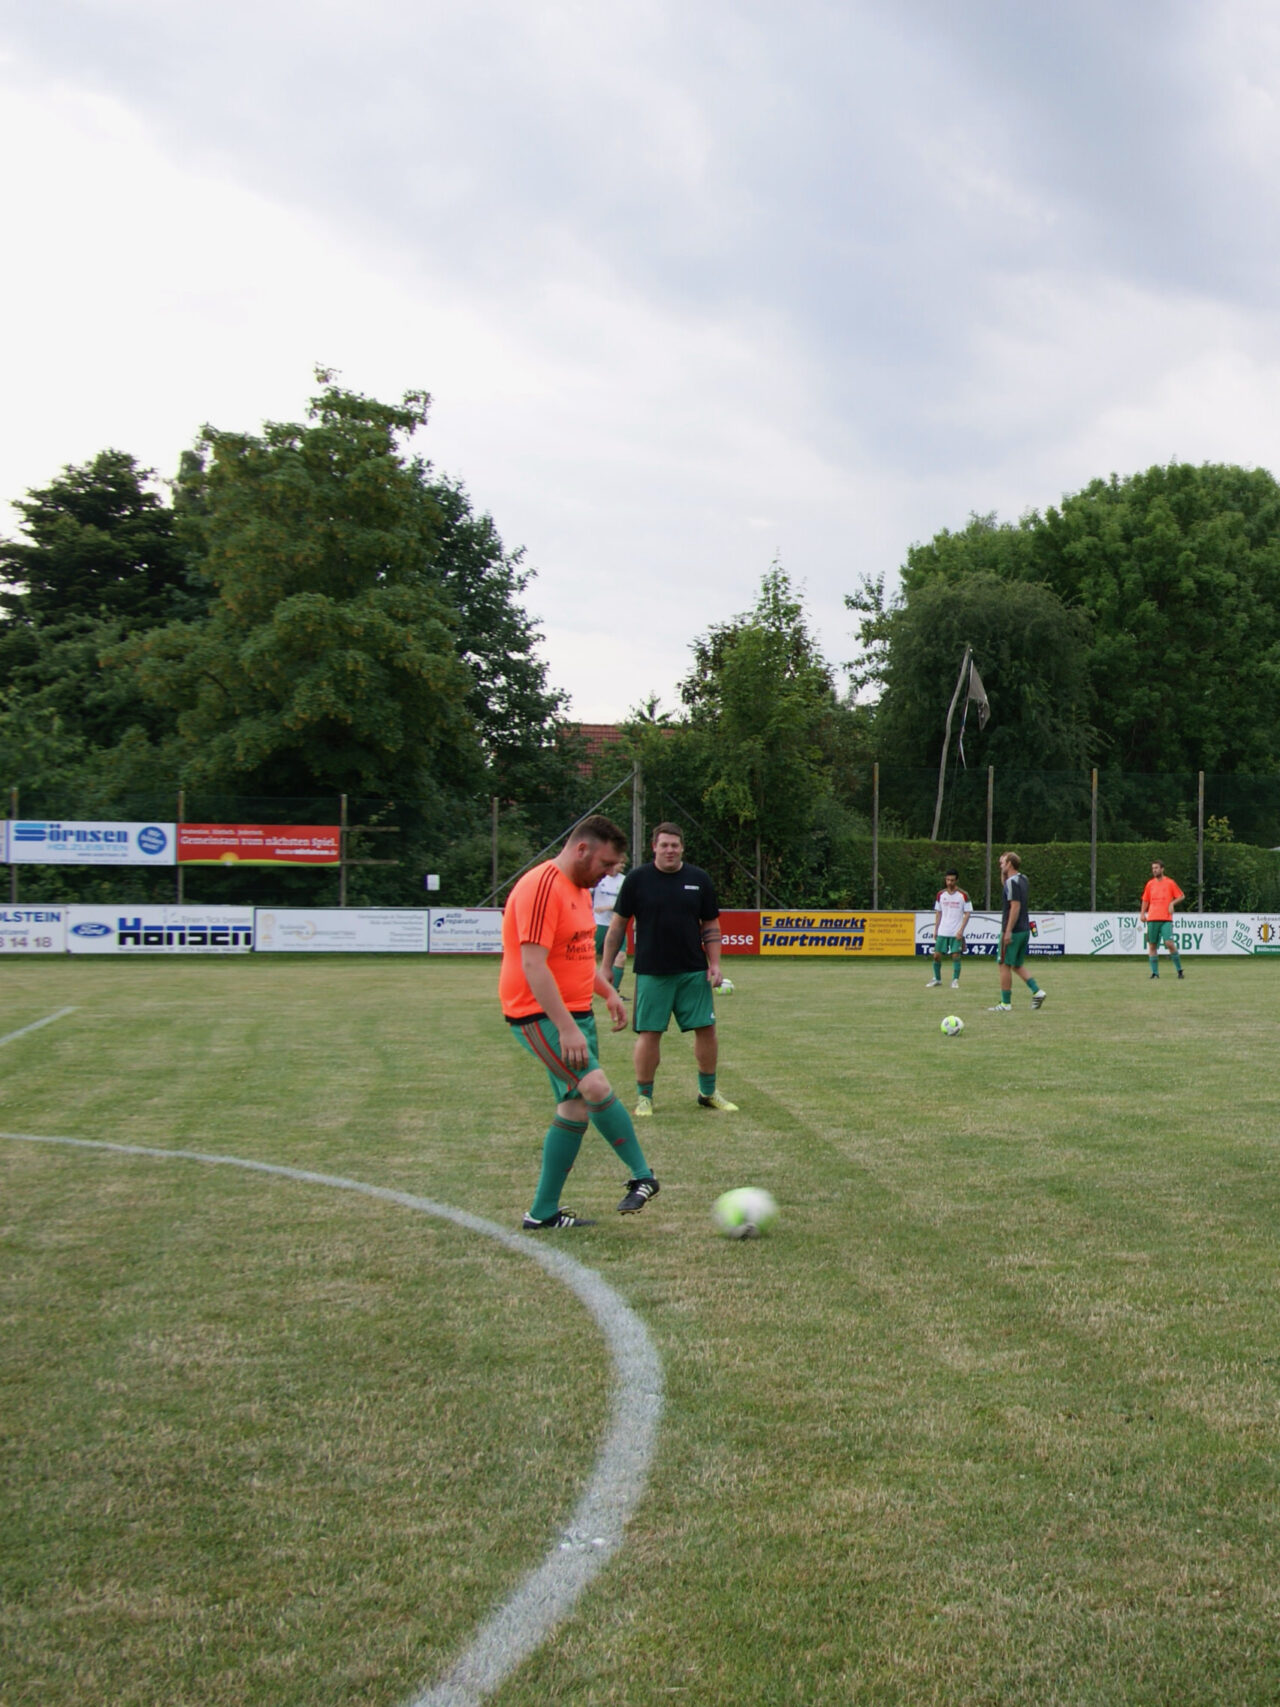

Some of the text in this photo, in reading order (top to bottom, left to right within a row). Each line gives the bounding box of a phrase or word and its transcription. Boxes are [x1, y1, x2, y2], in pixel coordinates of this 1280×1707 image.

[14, 823, 128, 842] Sörnsen
[181, 836, 238, 845] Gemeinsam
[265, 837, 310, 846] nächsten
[775, 916, 815, 928] aktiv
[820, 917, 866, 928] markt
[1093, 919, 1110, 932] von
[1117, 917, 1138, 928] TSV
[1235, 919, 1251, 932] von
[77, 923, 107, 936] Ford
[118, 918, 252, 945] Hansen
[965, 931, 999, 940] chulTea
[10, 937, 28, 947] 14
[34, 937, 52, 947] 18
[721, 934, 753, 944] asse
[762, 933, 863, 947] Hartmann
[1091, 929, 1112, 947] 1920
[1144, 933, 1204, 950] ARBY
[1232, 929, 1254, 948] 1920
[972, 945, 985, 954] 42
